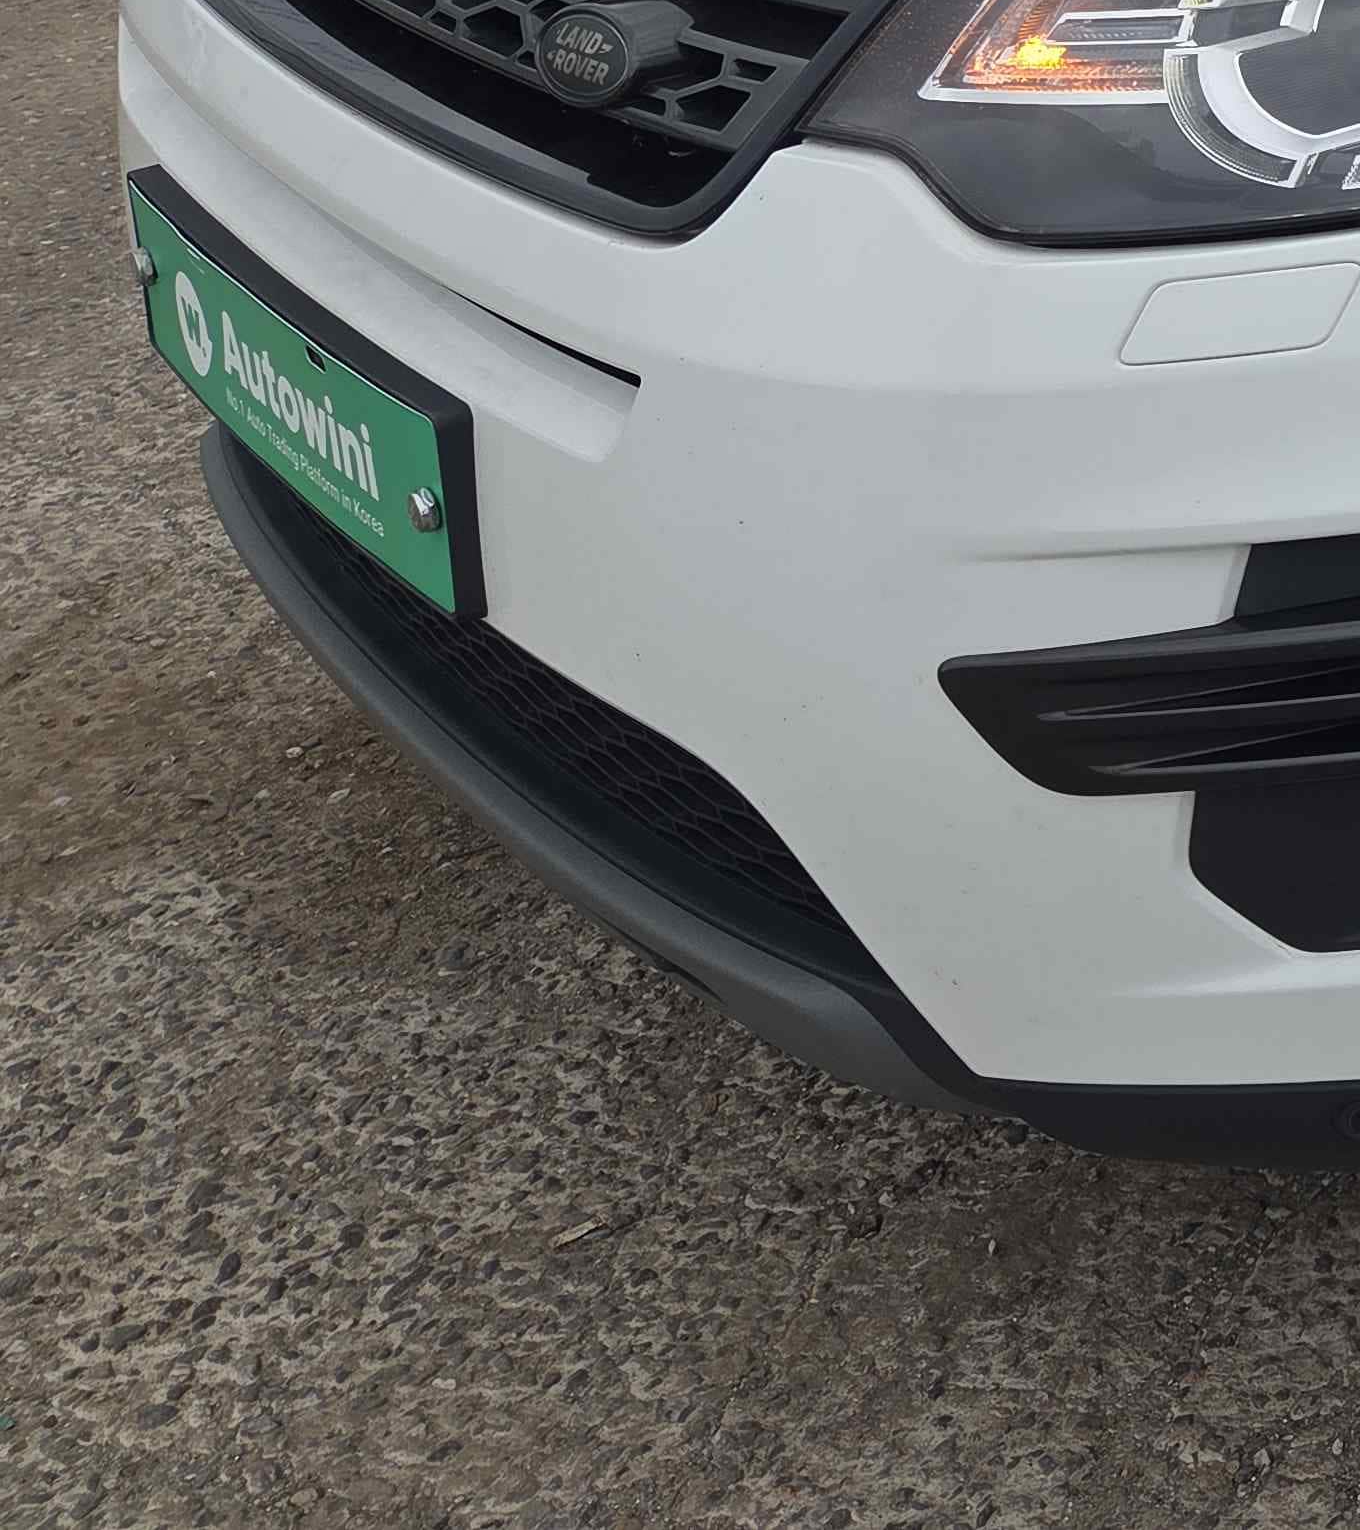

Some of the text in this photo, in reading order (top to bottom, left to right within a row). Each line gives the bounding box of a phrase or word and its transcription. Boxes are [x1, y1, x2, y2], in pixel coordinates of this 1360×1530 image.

[552, 47, 610, 87] ROVER
[555, 22, 604, 55] LAND
[221, 310, 380, 502] Autowini
[265, 423, 300, 471] Trading
[300, 453, 341, 503] Platform
[352, 500, 385, 538] Korea
